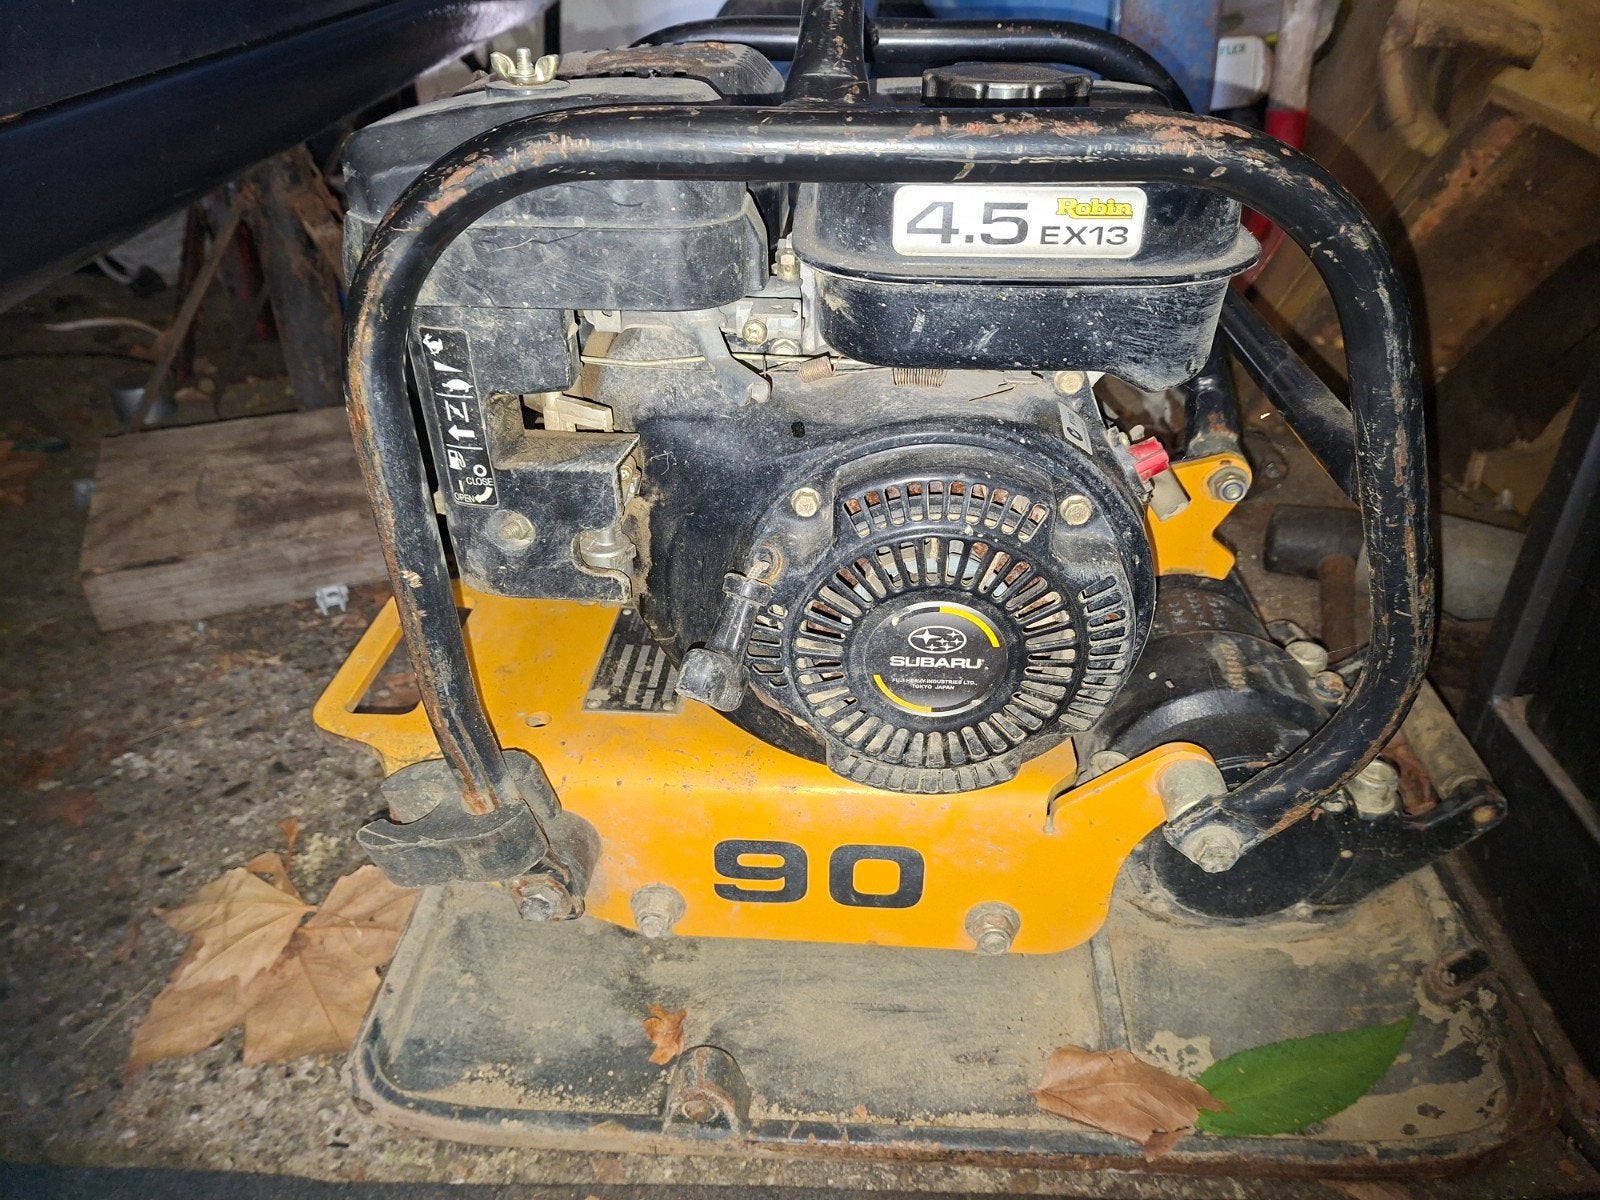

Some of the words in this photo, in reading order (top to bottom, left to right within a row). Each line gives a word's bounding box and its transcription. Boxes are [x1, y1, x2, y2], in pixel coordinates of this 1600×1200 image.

[1056, 197, 1134, 220] Robin
[906, 201, 1029, 246] 4.5
[1039, 225, 1129, 246] EX13
[465, 476, 494, 486] CLOSE
[454, 492, 475, 503] OPEN
[889, 655, 982, 669] SUBARU
[713, 839, 925, 909] 90
